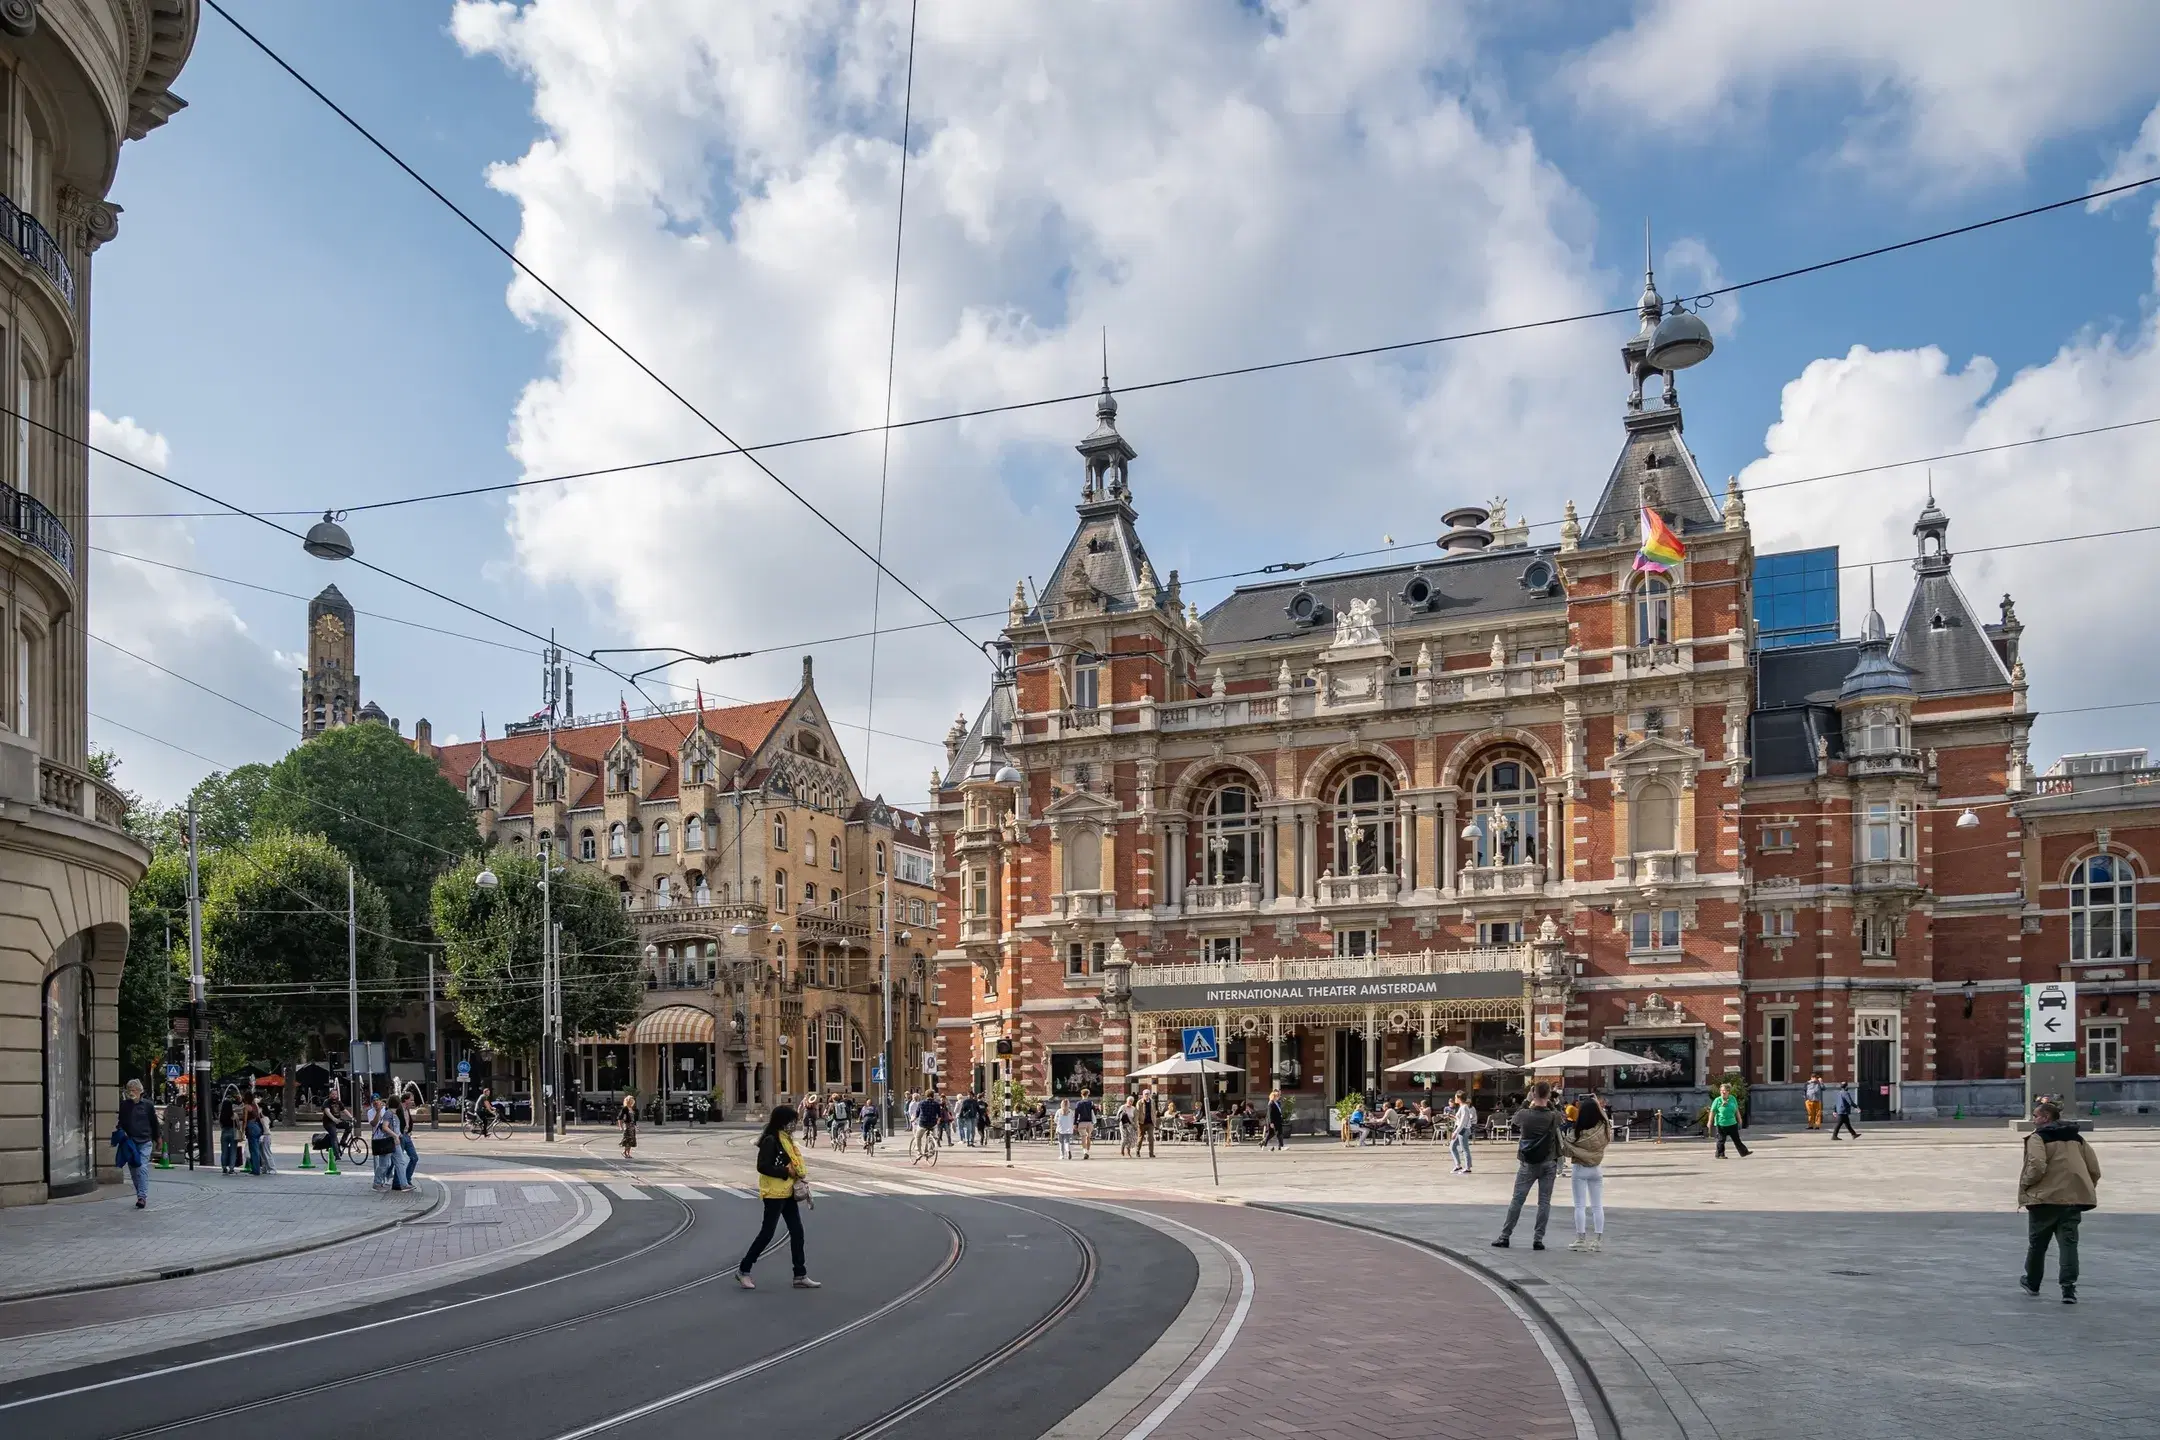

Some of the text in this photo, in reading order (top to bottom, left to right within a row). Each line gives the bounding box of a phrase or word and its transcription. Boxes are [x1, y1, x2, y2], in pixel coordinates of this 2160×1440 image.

[1207, 982, 1437, 1001] INTERNATIONAAL THEATER AMSTERDAM
